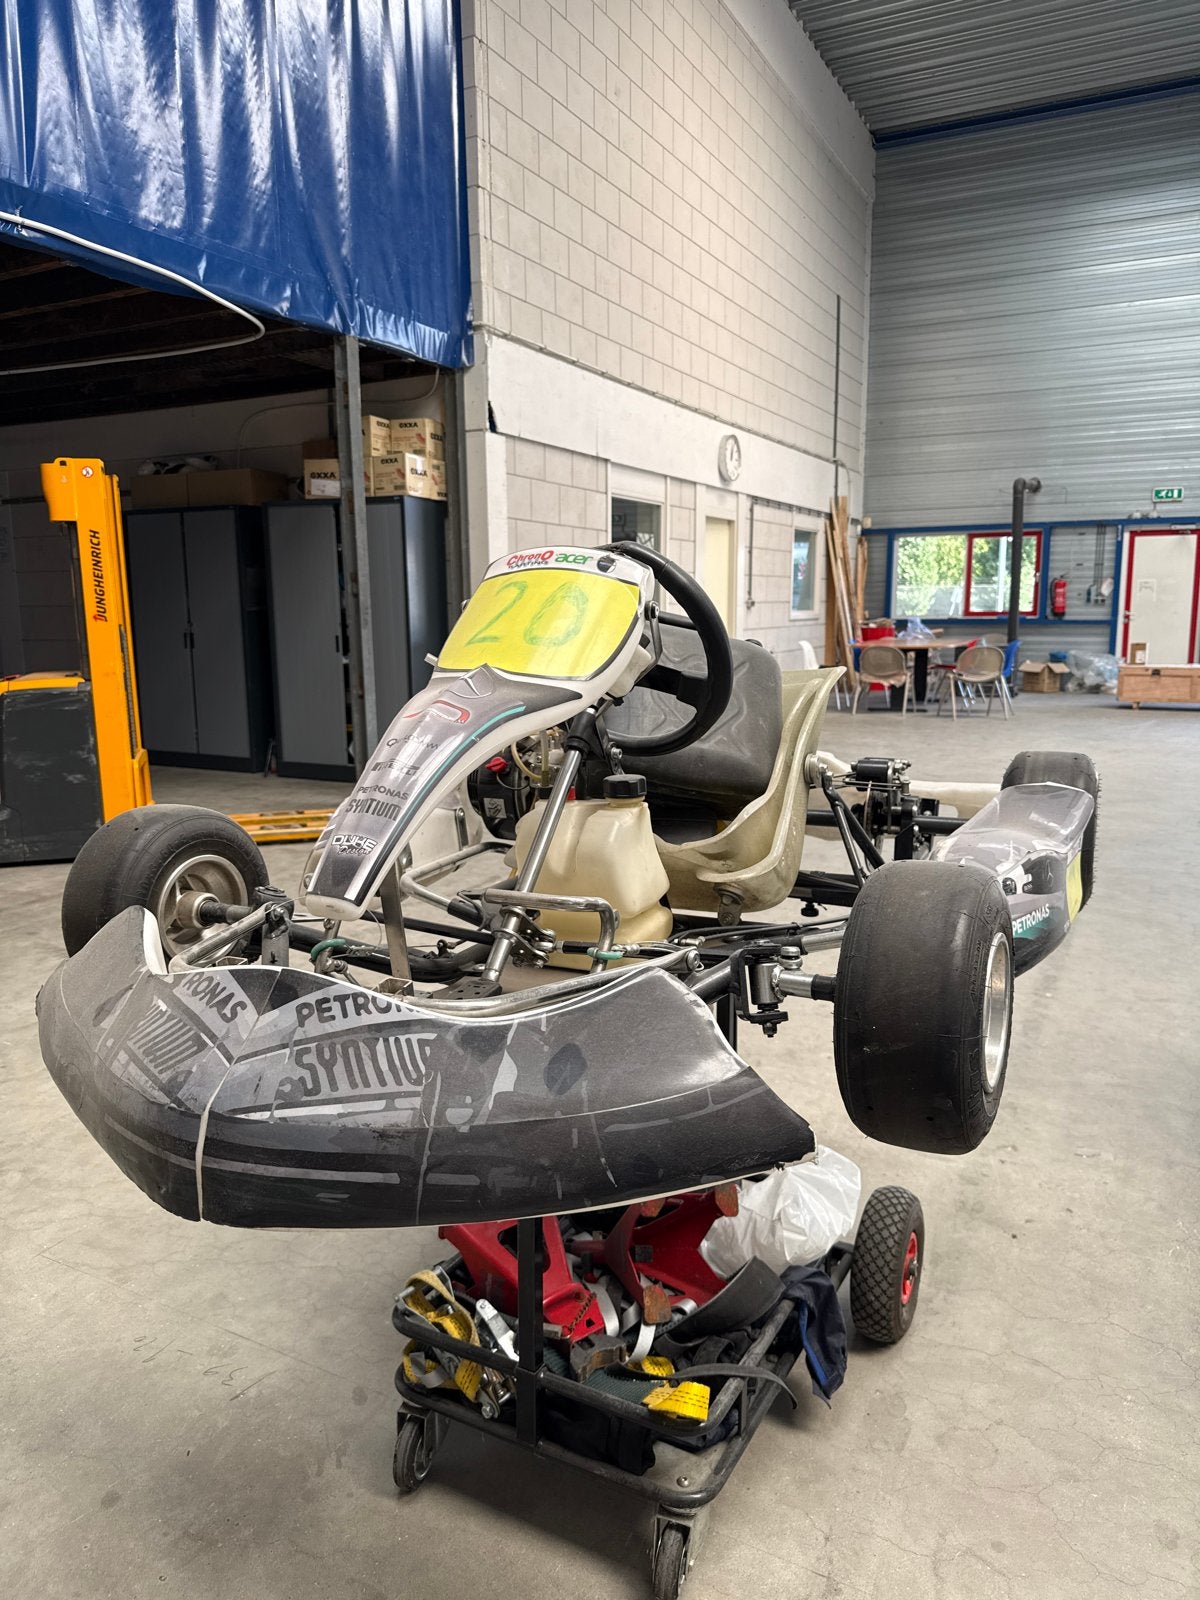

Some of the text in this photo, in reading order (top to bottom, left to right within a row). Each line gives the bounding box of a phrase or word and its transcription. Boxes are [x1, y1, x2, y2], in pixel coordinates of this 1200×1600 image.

[555, 553, 593, 565] acer
[89, 529, 108, 622] JUNGHEINRICH
[464, 579, 589, 648] 20
[357, 784, 409, 801] PETRONAS
[332, 835, 378, 851] DUKE
[1011, 903, 1050, 937] PETRONAS
